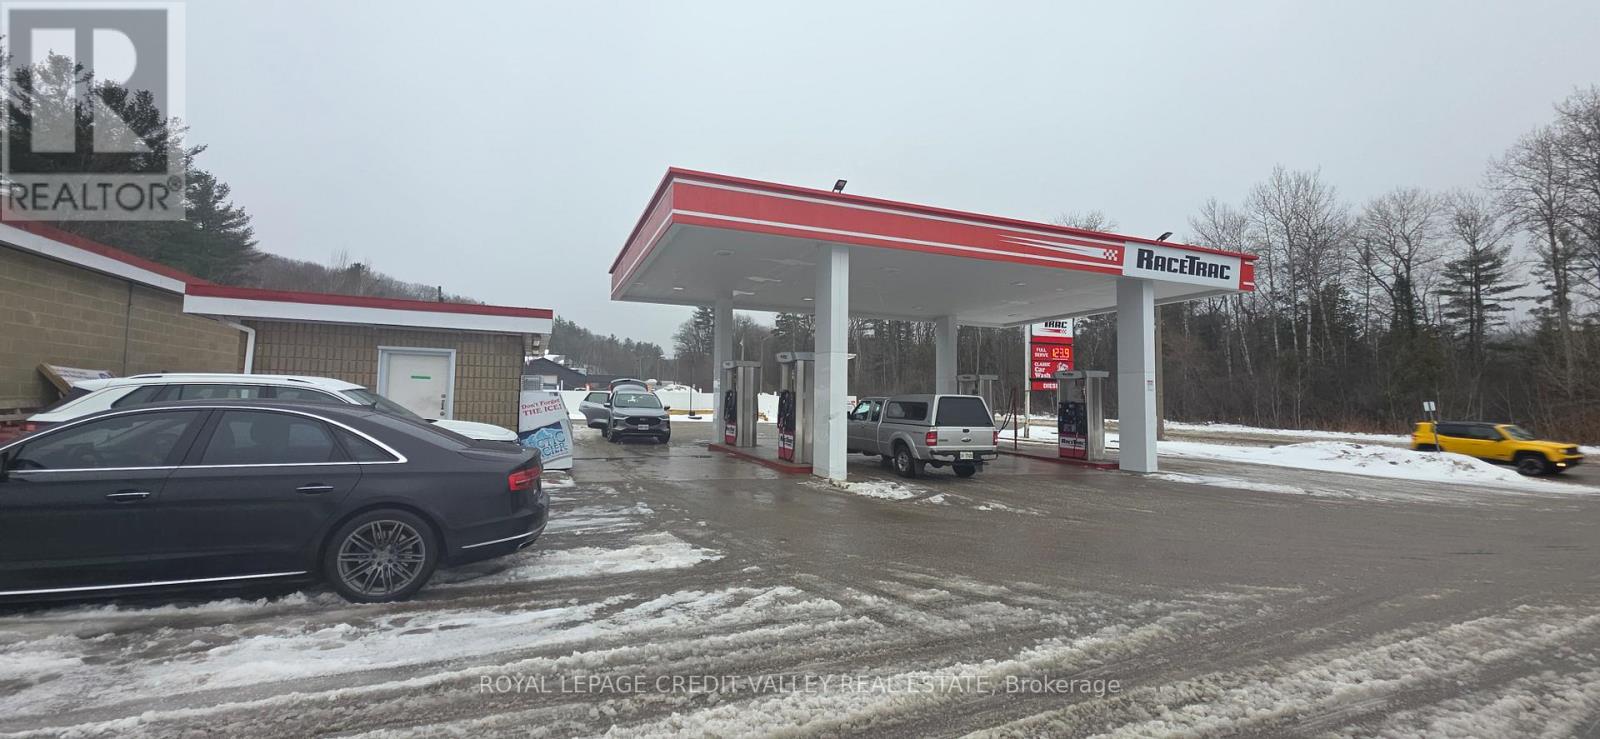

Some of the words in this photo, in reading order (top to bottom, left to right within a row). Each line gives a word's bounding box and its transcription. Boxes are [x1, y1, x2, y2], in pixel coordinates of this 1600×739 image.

[521, 402, 539, 410] Don't
[523, 407, 542, 416] THE
[544, 403, 562, 412] ICE!
